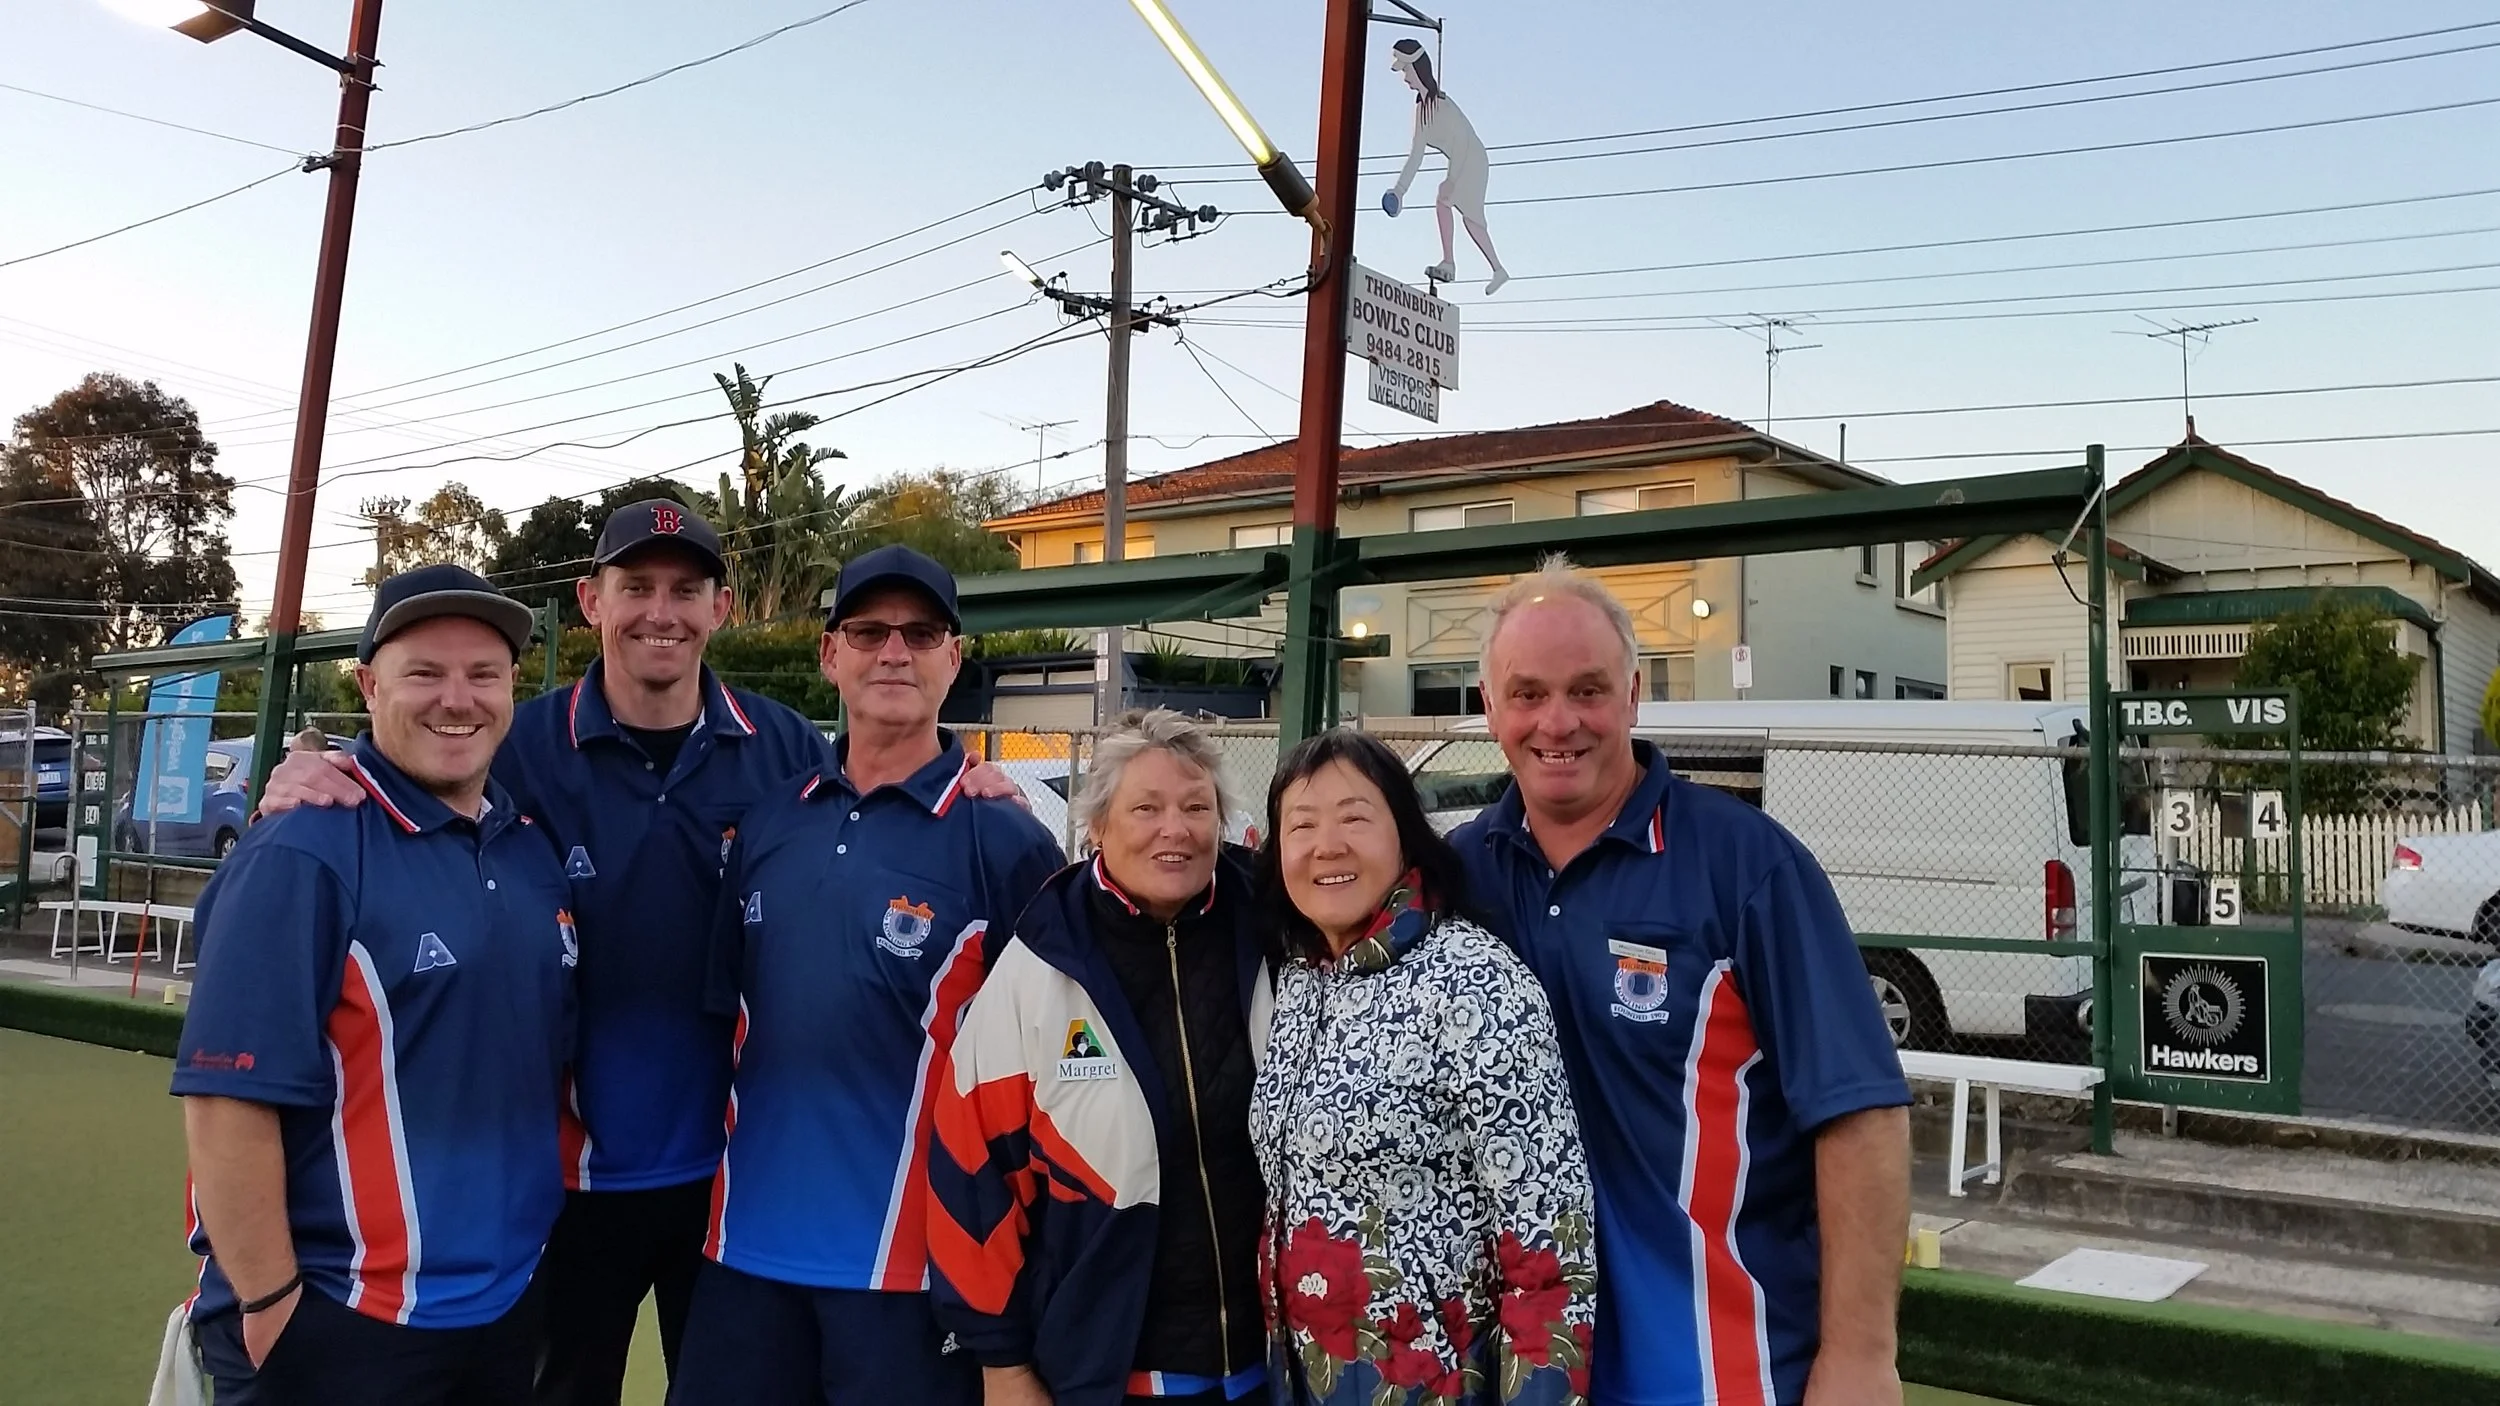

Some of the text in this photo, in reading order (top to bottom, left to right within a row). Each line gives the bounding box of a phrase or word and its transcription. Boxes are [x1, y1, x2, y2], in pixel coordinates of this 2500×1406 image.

[1365, 274, 1444, 322] THORNBURY
[1353, 297, 1455, 356] BOWLS CLUB
[1378, 362, 1432, 398] VISITORS
[1374, 384, 1434, 420] WELCOME
[651, 505, 684, 535] B
[2226, 698, 2287, 725] VIS
[2170, 801, 2191, 833] 3
[2258, 801, 2280, 832] 4
[2214, 888, 2236, 919] 5
[1059, 1063, 1117, 1079] Margret
[2151, 1043, 2259, 1073] Hawkers
